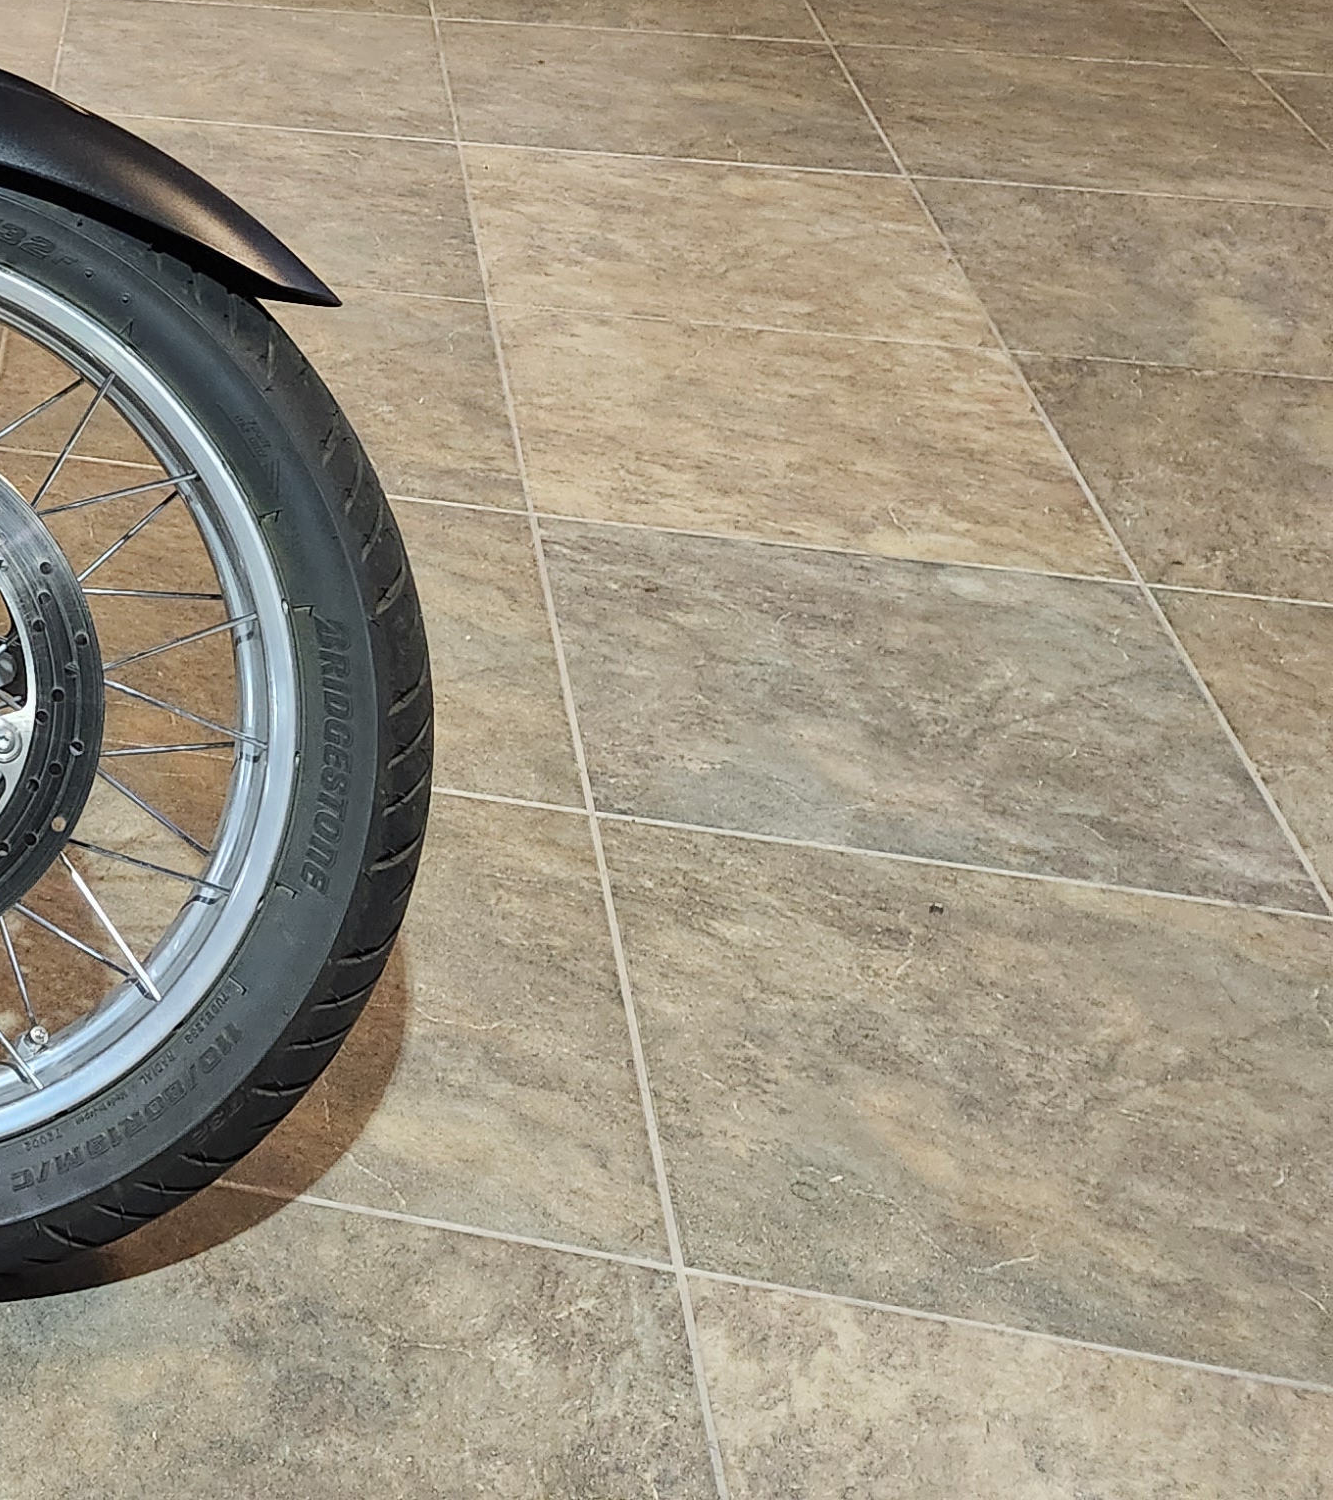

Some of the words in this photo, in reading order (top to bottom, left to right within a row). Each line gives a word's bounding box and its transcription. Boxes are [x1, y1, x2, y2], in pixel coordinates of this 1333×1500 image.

[300, 612, 354, 896] BRIDGESTONE
[184, 991, 231, 1045] TUBELESS
[140, 1049, 176, 1086] RADIAL
